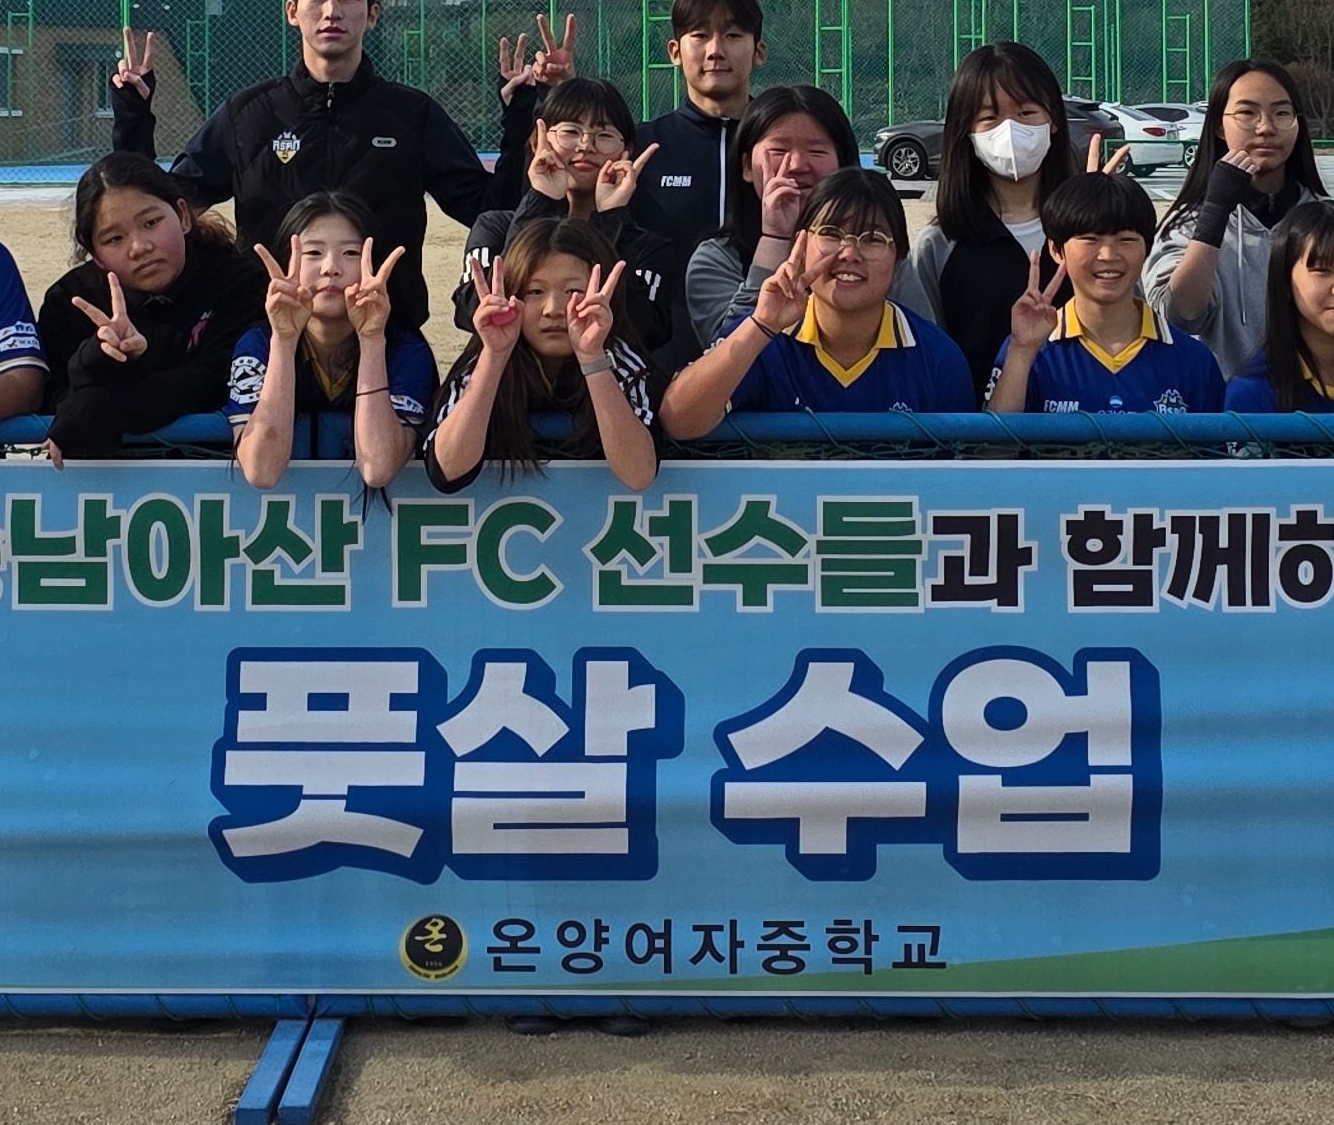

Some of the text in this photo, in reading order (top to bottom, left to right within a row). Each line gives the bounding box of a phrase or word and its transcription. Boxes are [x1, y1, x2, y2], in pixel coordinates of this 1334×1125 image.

[1043, 399, 1080, 414] FCMM
[392, 495, 564, 609] FC
[583, 495, 1037, 612] 선수들과
[215, 652, 1149, 873] 풋살 수업
[485, 917, 948, 976] 온양여자중학교
